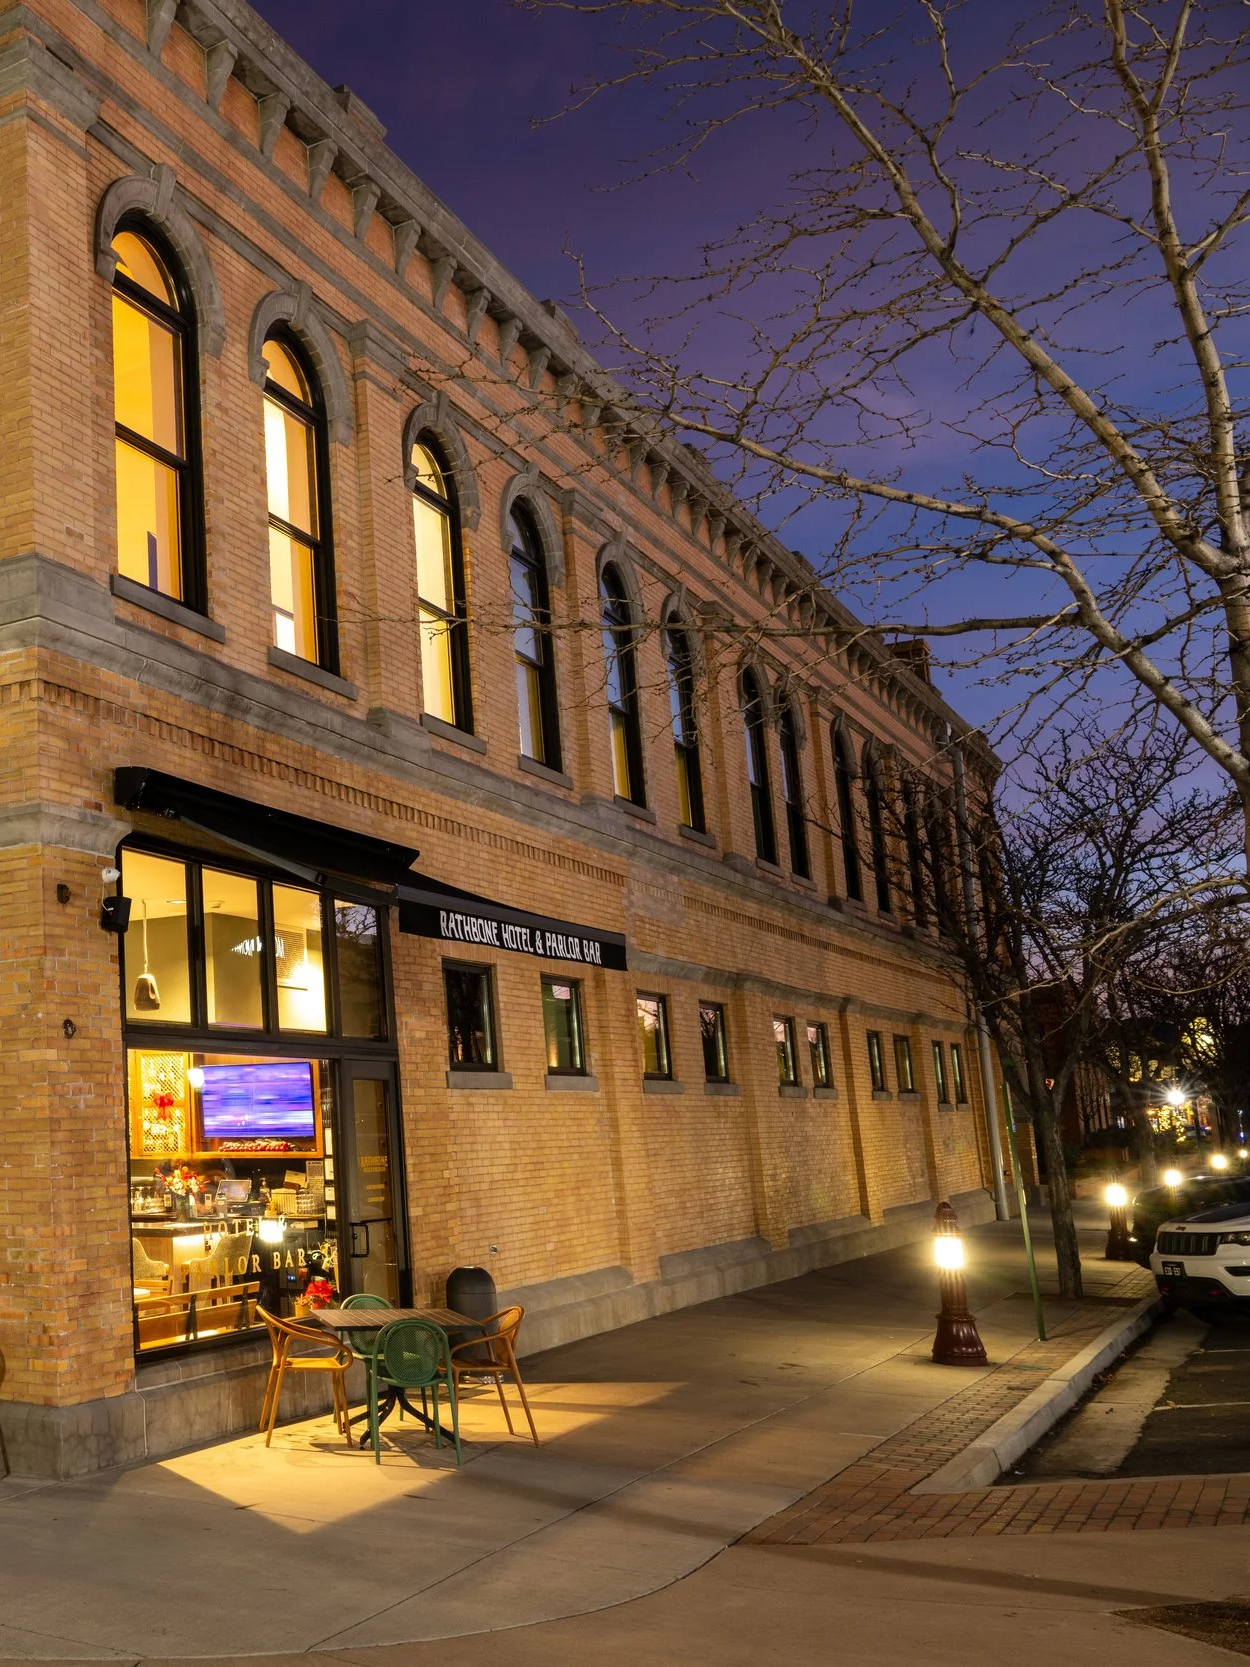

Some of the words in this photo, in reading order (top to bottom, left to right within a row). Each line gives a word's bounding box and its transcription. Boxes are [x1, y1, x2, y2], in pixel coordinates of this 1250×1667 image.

[440, 910, 500, 946] RATHBONE
[502, 924, 534, 953] HOTEL
[536, 931, 543, 954] &
[545, 932, 582, 961] PARLOR
[583, 942, 602, 965] BAR
[273, 1248, 307, 1270] BAR
